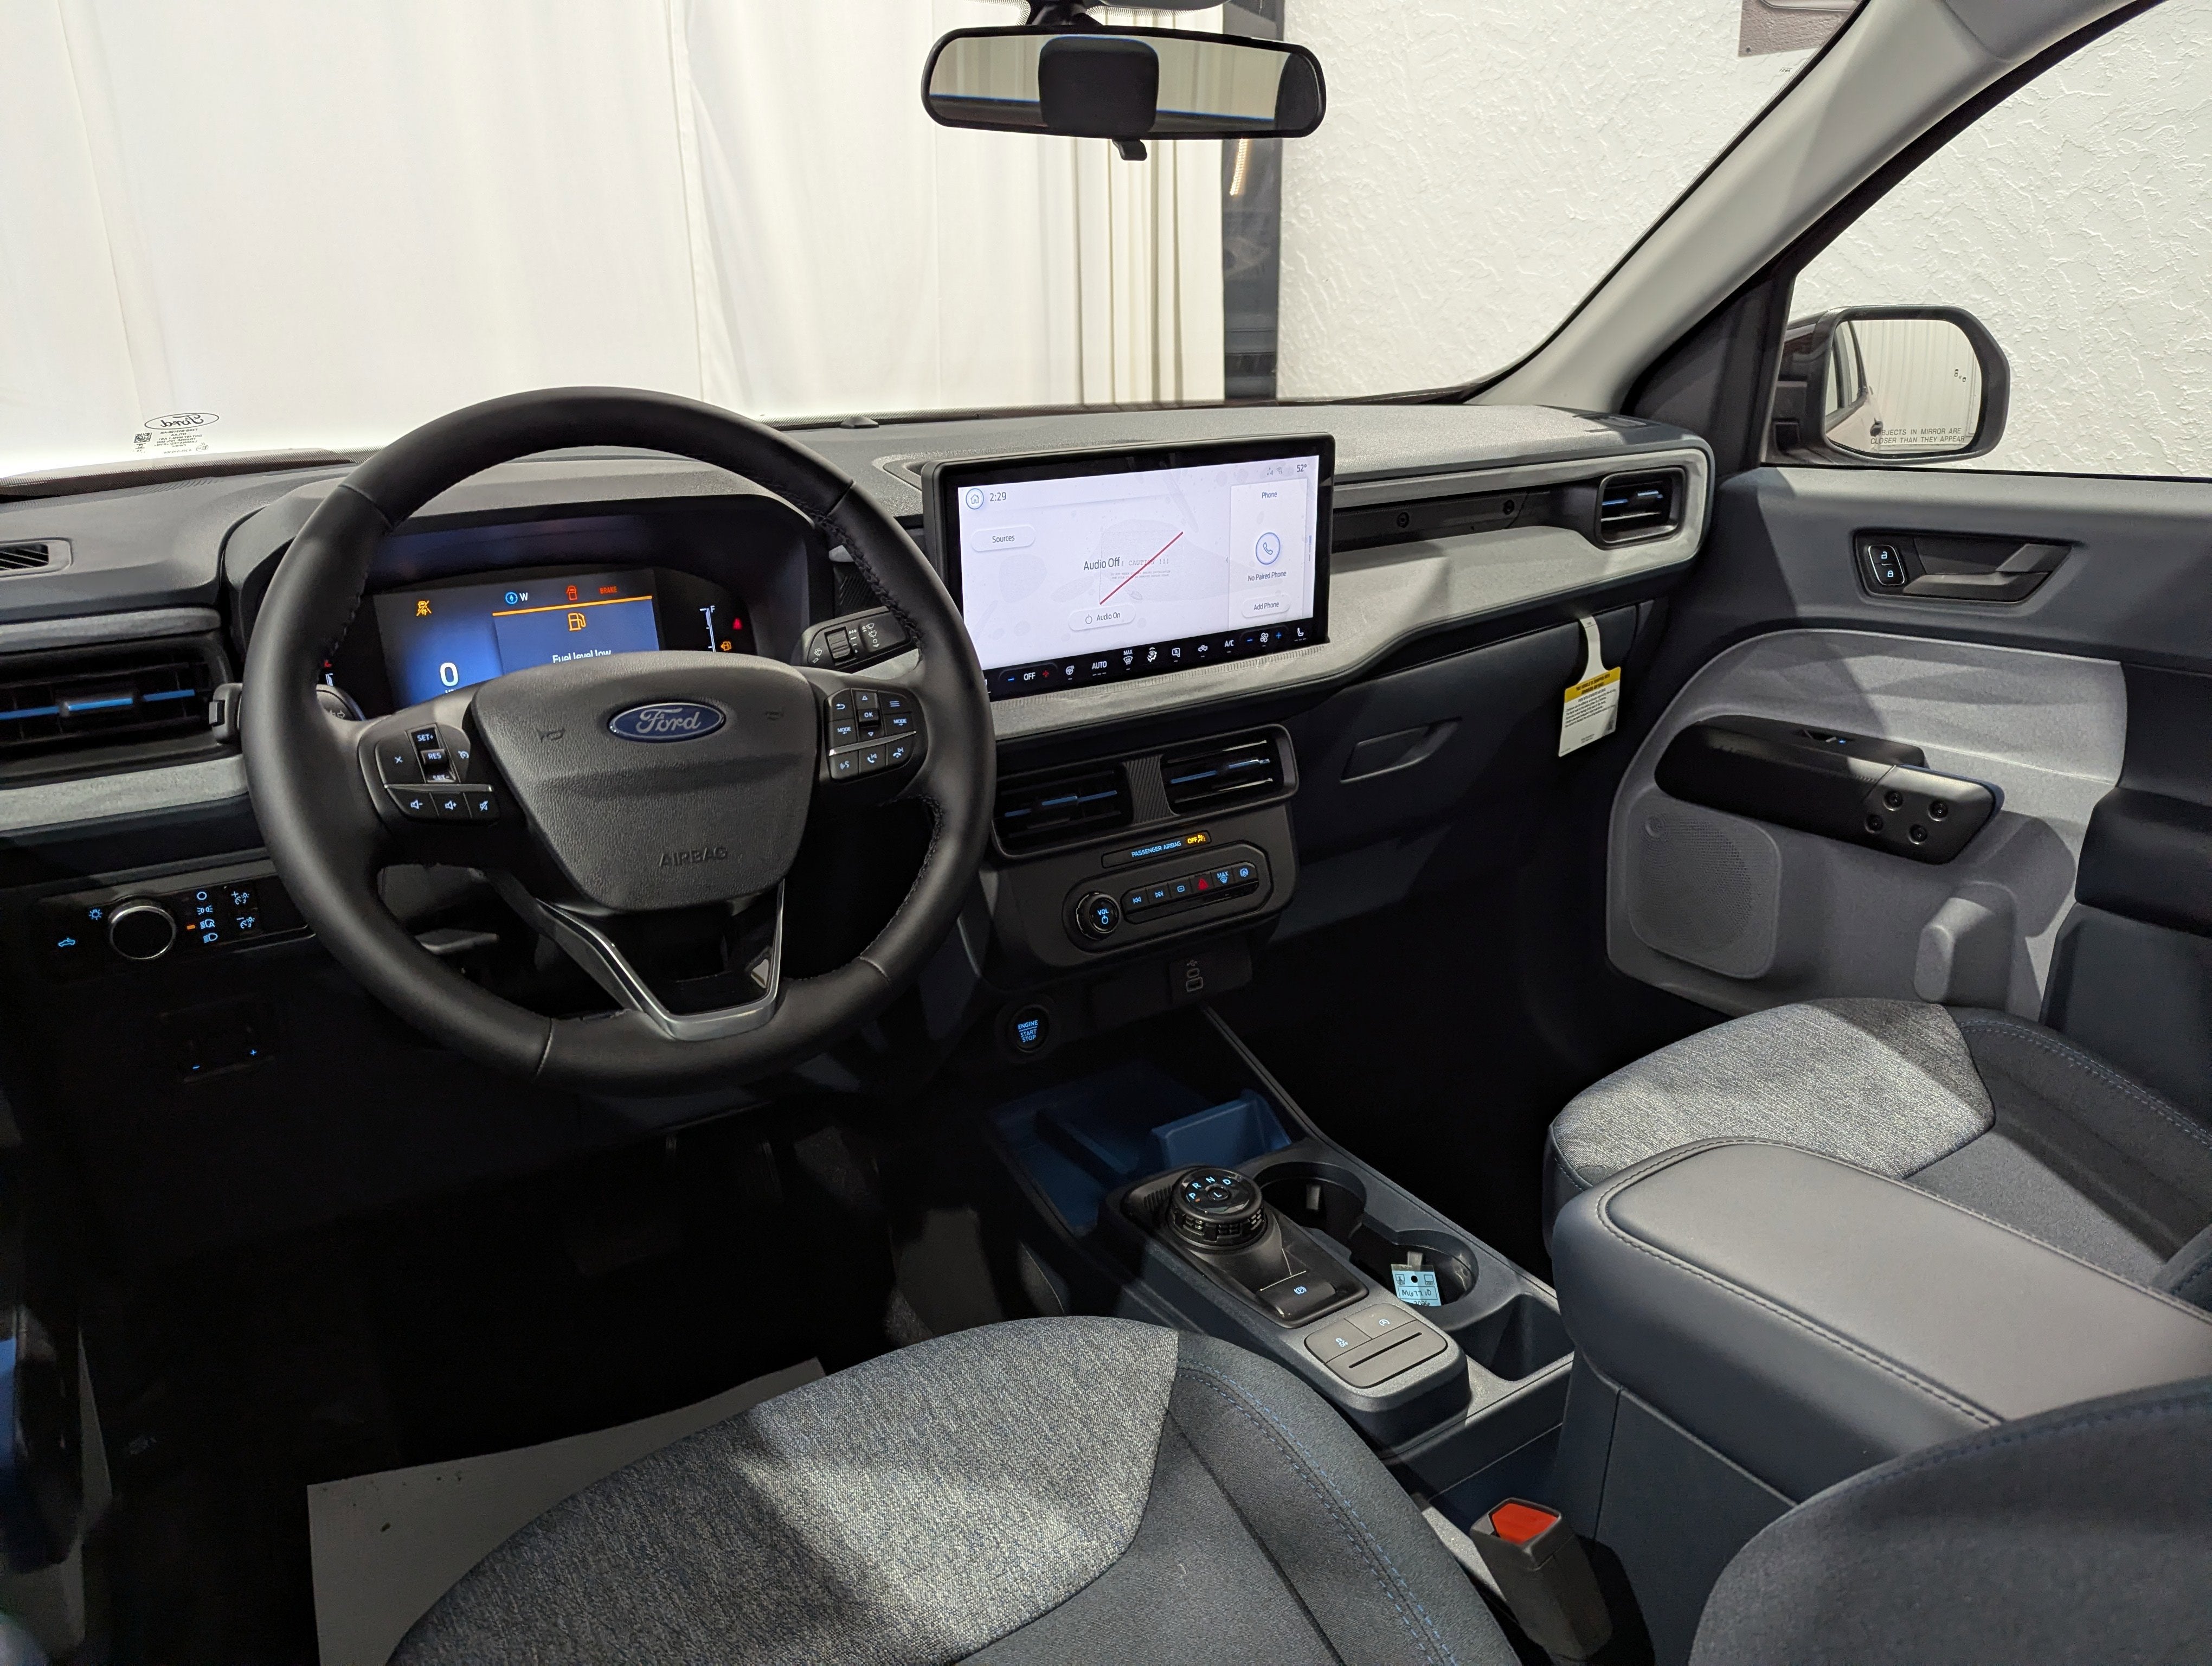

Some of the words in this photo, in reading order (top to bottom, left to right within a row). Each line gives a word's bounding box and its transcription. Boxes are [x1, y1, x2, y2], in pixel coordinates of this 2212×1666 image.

[989, 491, 1007, 502] 2:29
[992, 535, 1015, 543] Sources
[1083, 559, 1107, 571] Audio
[1108, 556, 1121, 568] Off
[599, 585, 618, 594] BRAKE
[519, 592, 528, 601] W
[710, 605, 715, 613] F
[1253, 603, 1264, 611] Add
[1096, 612, 1112, 621] Audio
[1224, 639, 1234, 648] A/C
[1091, 661, 1107, 670] AUTO
[440, 662, 459, 687] 0
[1023, 671, 1036, 681] OFF
[635, 707, 702, 734] Ford
[1131, 845, 1162, 857] PASSENGER
[1163, 841, 1182, 850] AIRBAG
[658, 846, 728, 868] AIRBAG
[1217, 870, 1229, 879] MAX
[1018, 1020, 1038, 1030] ENGINE
[1020, 1029, 1037, 1038] START
[1022, 1034, 1037, 1043] STOP
